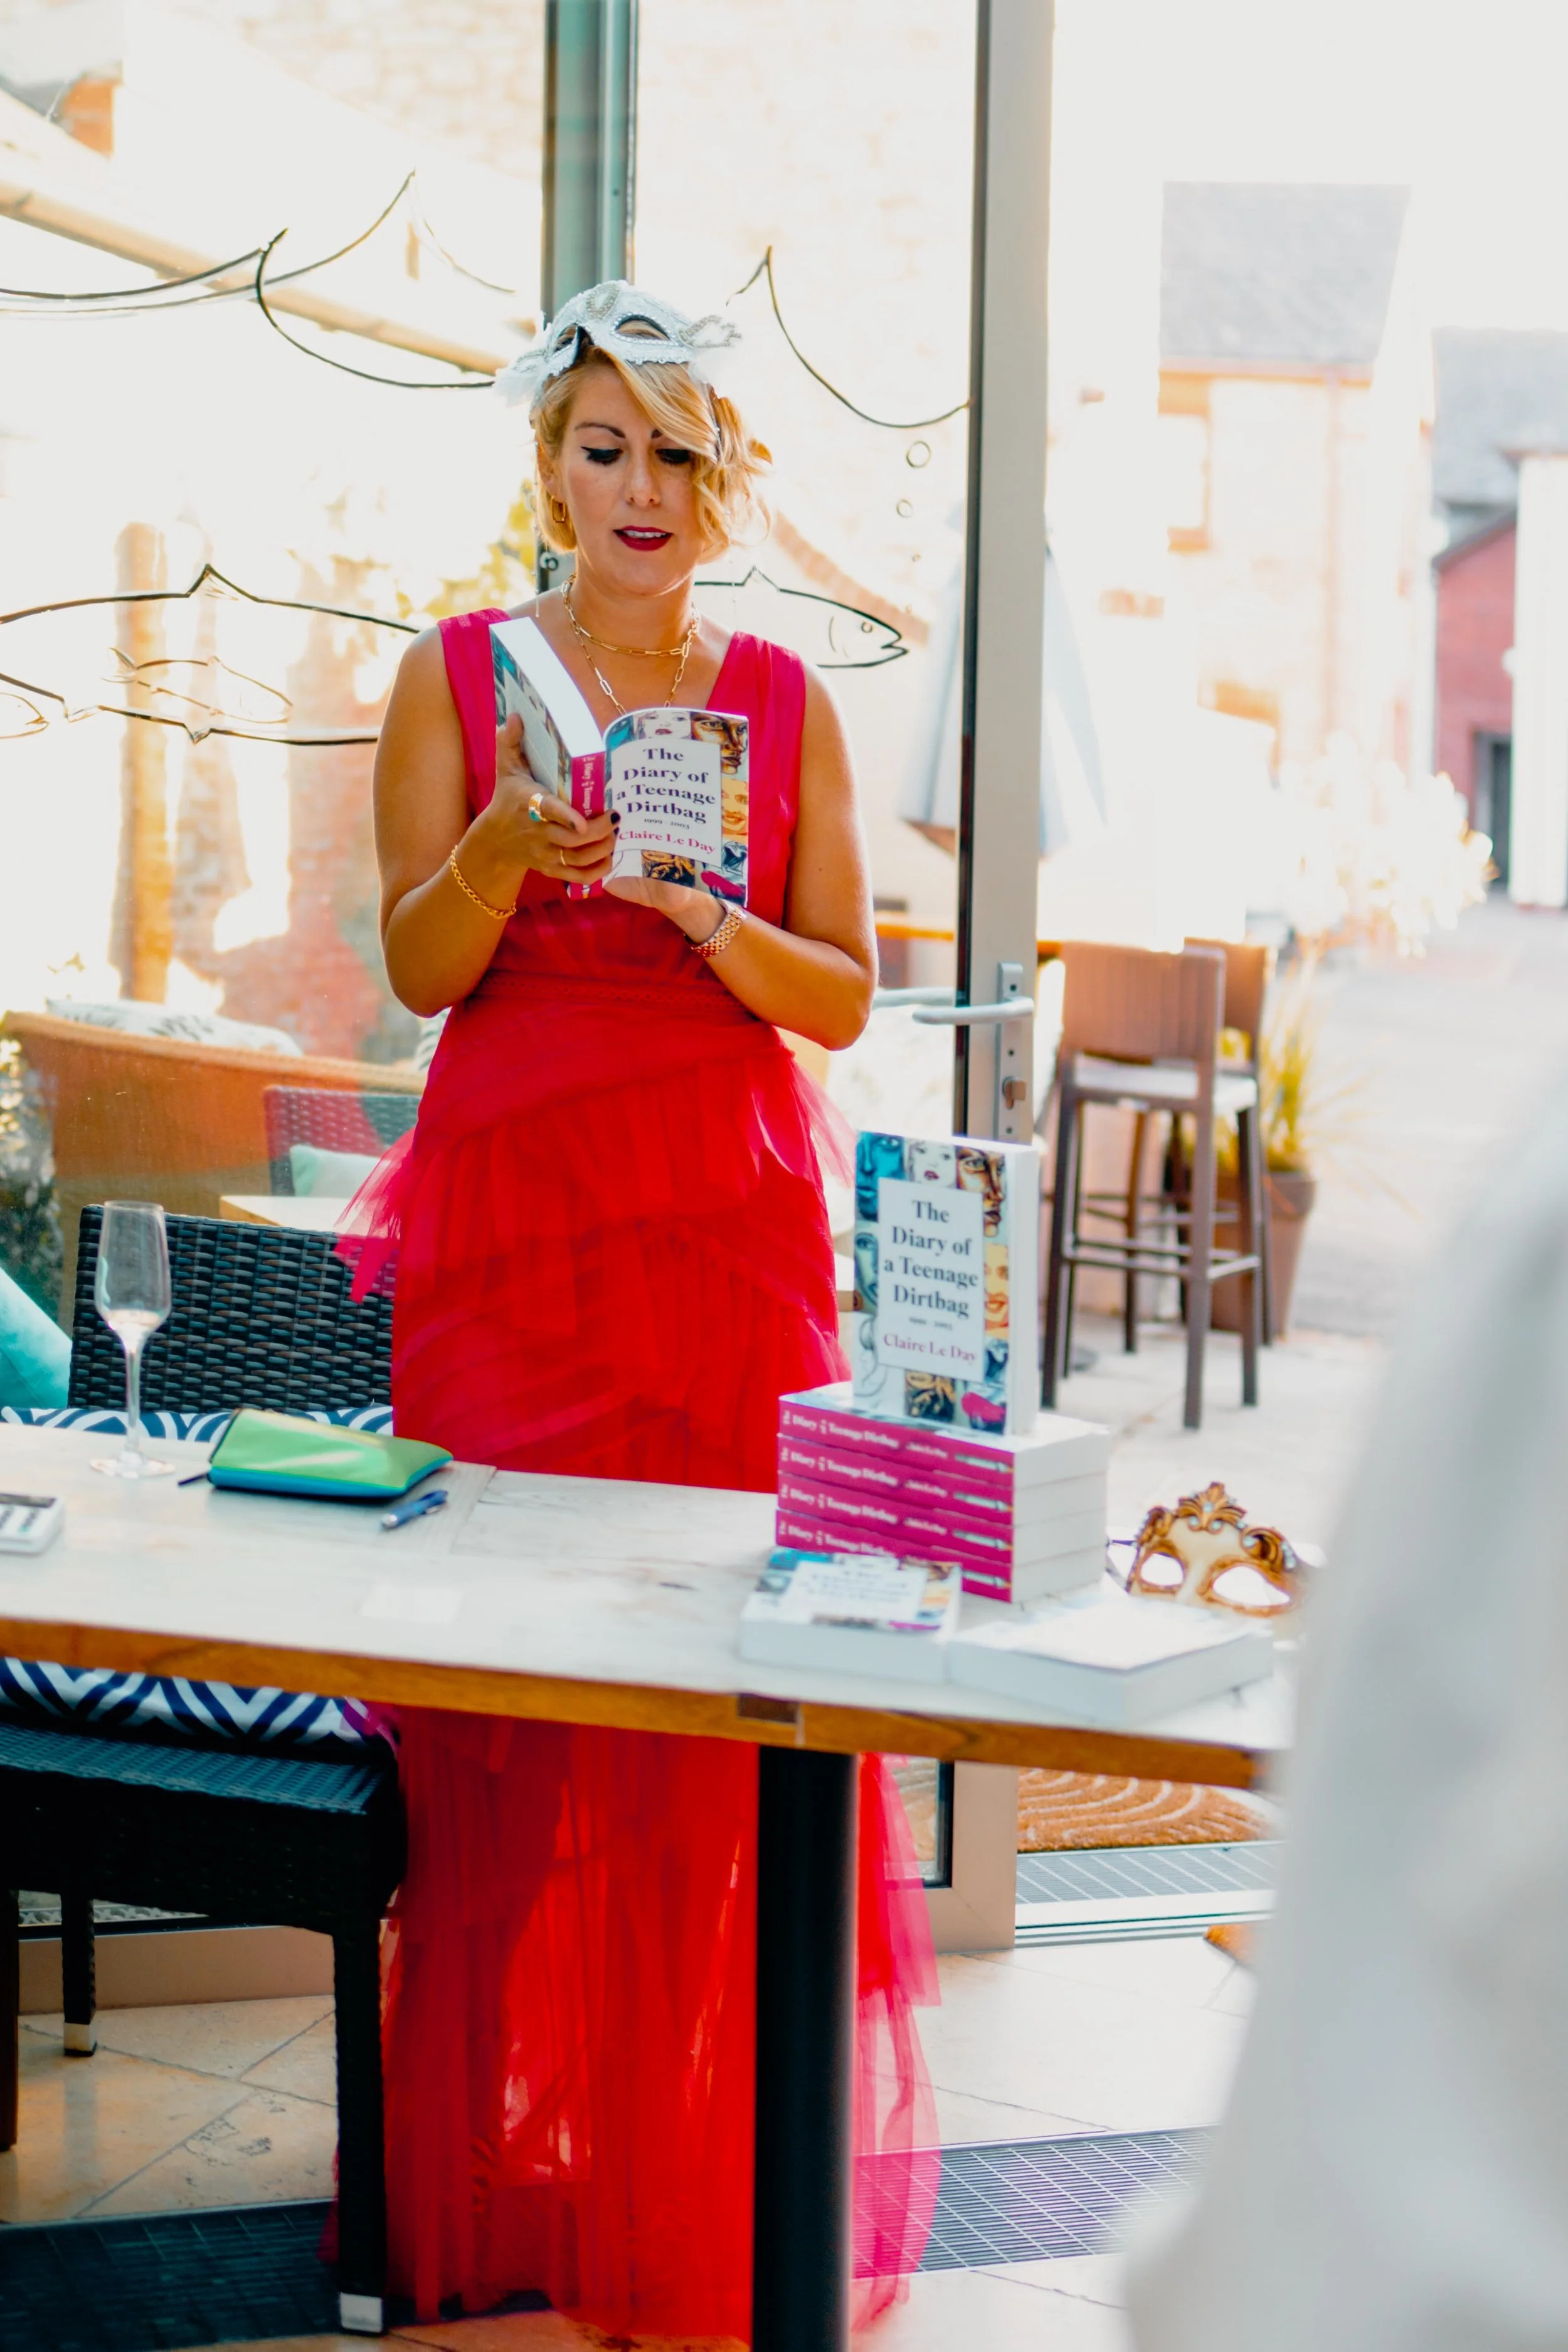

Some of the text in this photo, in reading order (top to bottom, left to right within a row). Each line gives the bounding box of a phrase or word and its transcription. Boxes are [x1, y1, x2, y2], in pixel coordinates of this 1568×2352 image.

[643, 748, 684, 761] The
[623, 766, 709, 783] Diary of
[617, 784, 716, 805] a Teenage
[627, 801, 706, 825] Dirtbag
[618, 830, 715, 854] Claire Le Day
[912, 1200, 950, 1223] The
[892, 1226, 972, 1256] Diary of
[884, 1256, 979, 1290] a Teenage
[893, 1285, 970, 1319] Dirtbag
[884, 1333, 977, 1365] Claire Le Day
